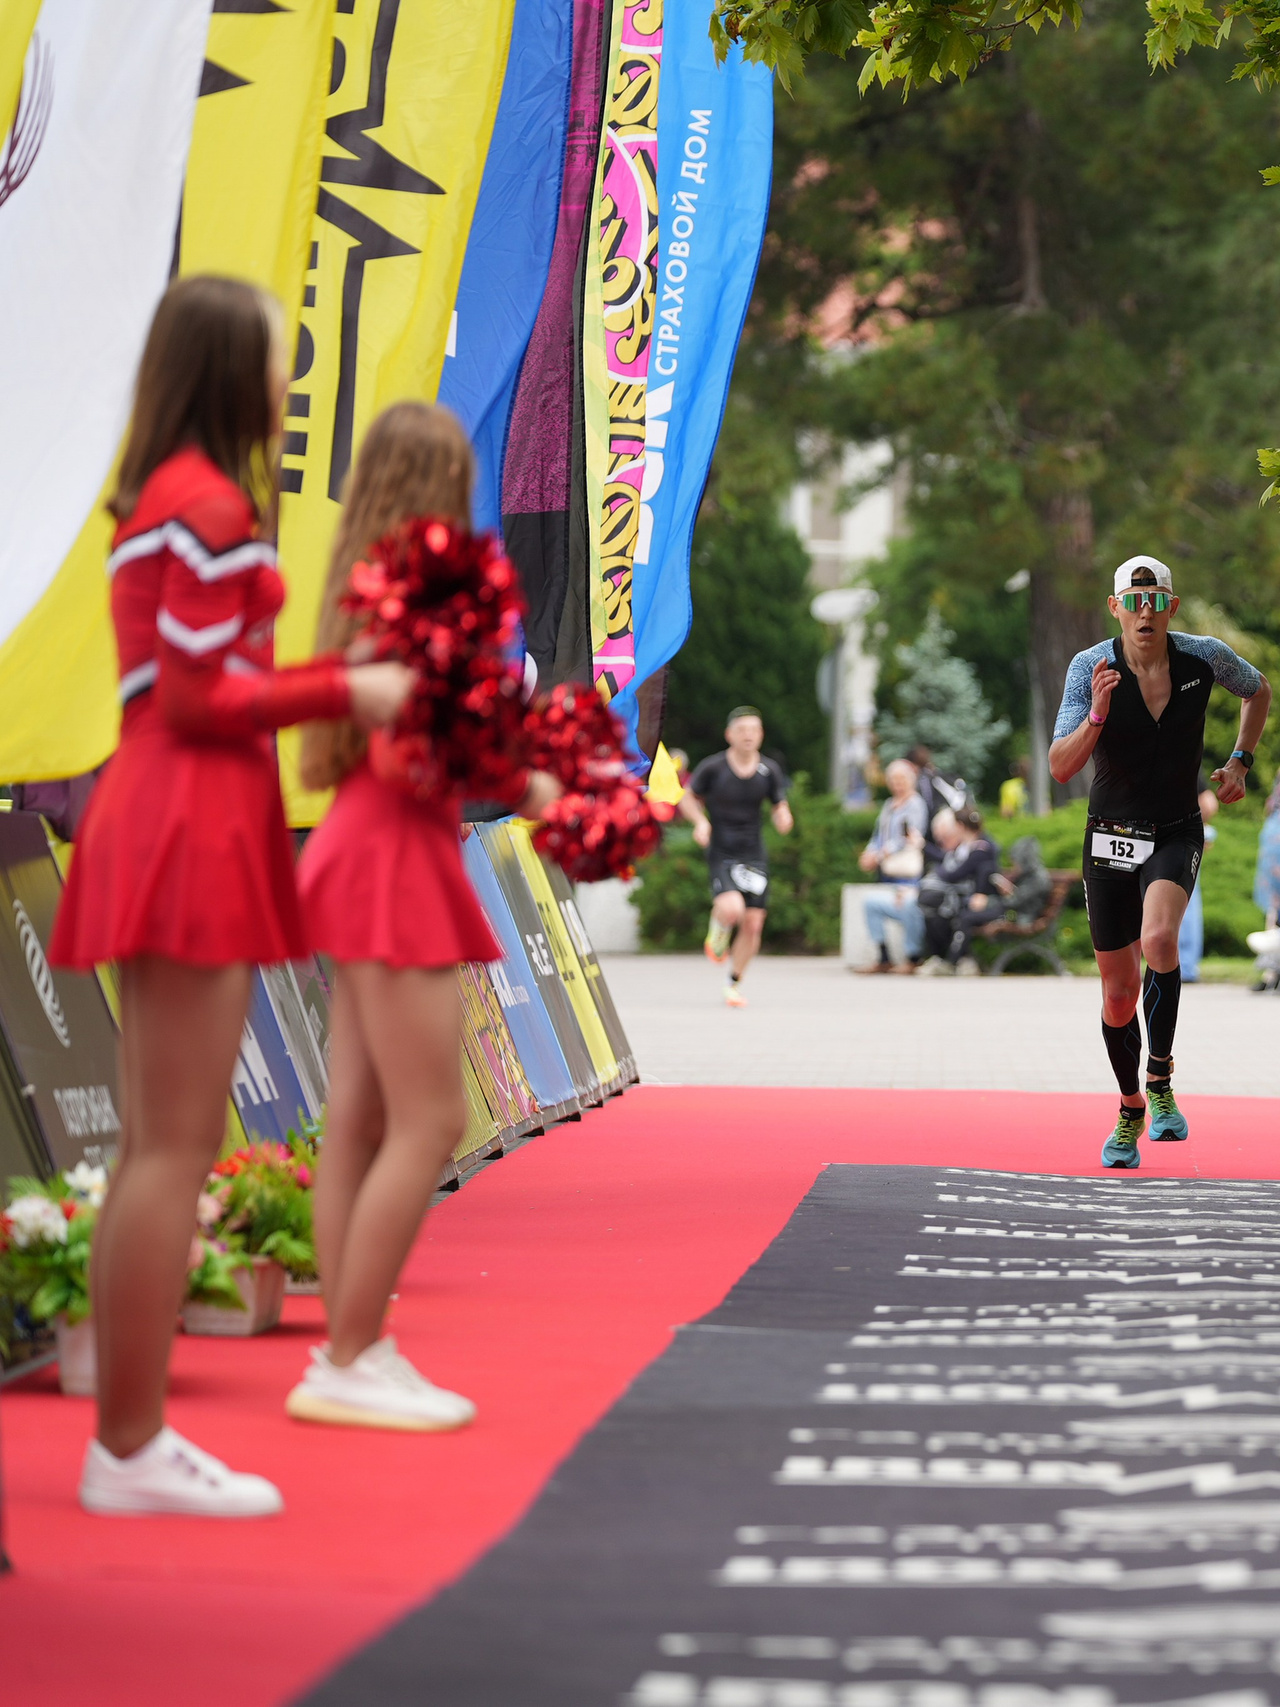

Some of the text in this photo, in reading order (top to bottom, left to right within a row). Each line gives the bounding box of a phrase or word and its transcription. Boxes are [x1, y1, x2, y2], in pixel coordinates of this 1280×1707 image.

[655, 191, 698, 376] СТРАХОВОЙ
[681, 109, 712, 184] ДОМ
[1109, 839, 1134, 859] 152
